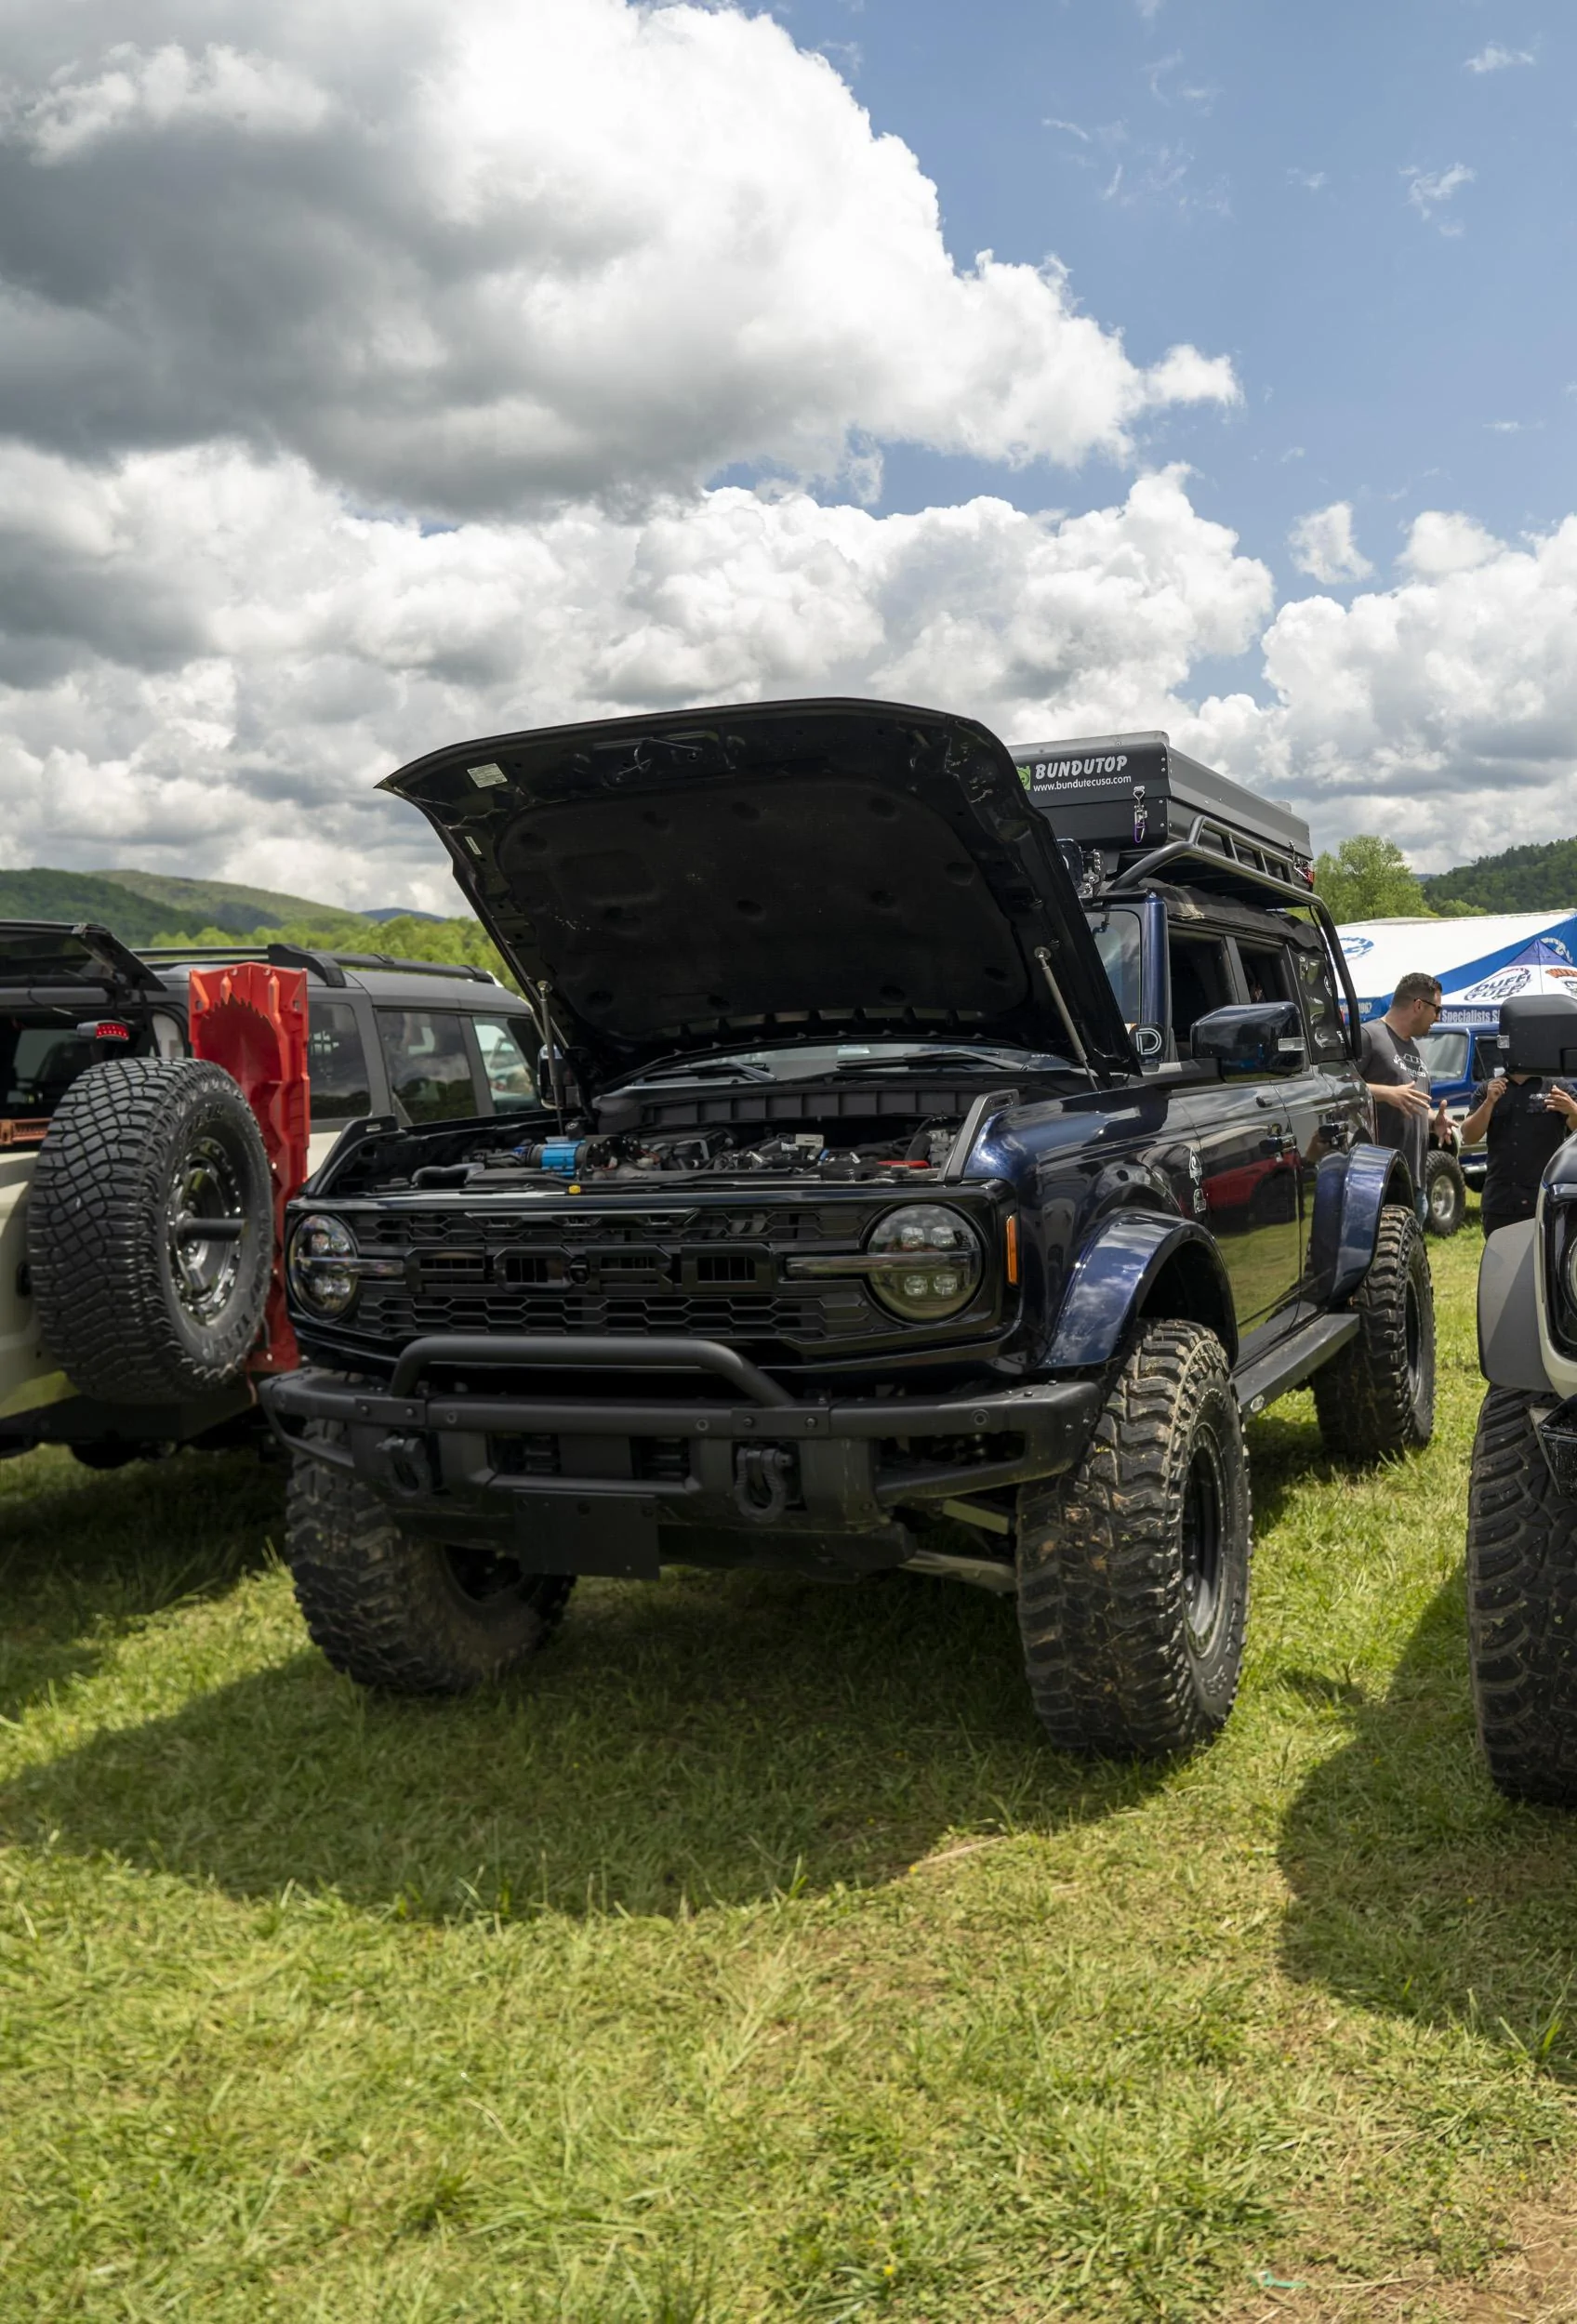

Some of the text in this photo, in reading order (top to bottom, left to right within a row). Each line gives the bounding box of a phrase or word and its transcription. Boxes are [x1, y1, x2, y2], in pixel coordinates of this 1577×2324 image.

[1035, 755, 1128, 780] BUNDUTOP
[1033, 775, 1132, 792] www.bundutecusa.com
[1441, 1009, 1491, 1023] Specialists
[405, 1246, 773, 1294] FORD
